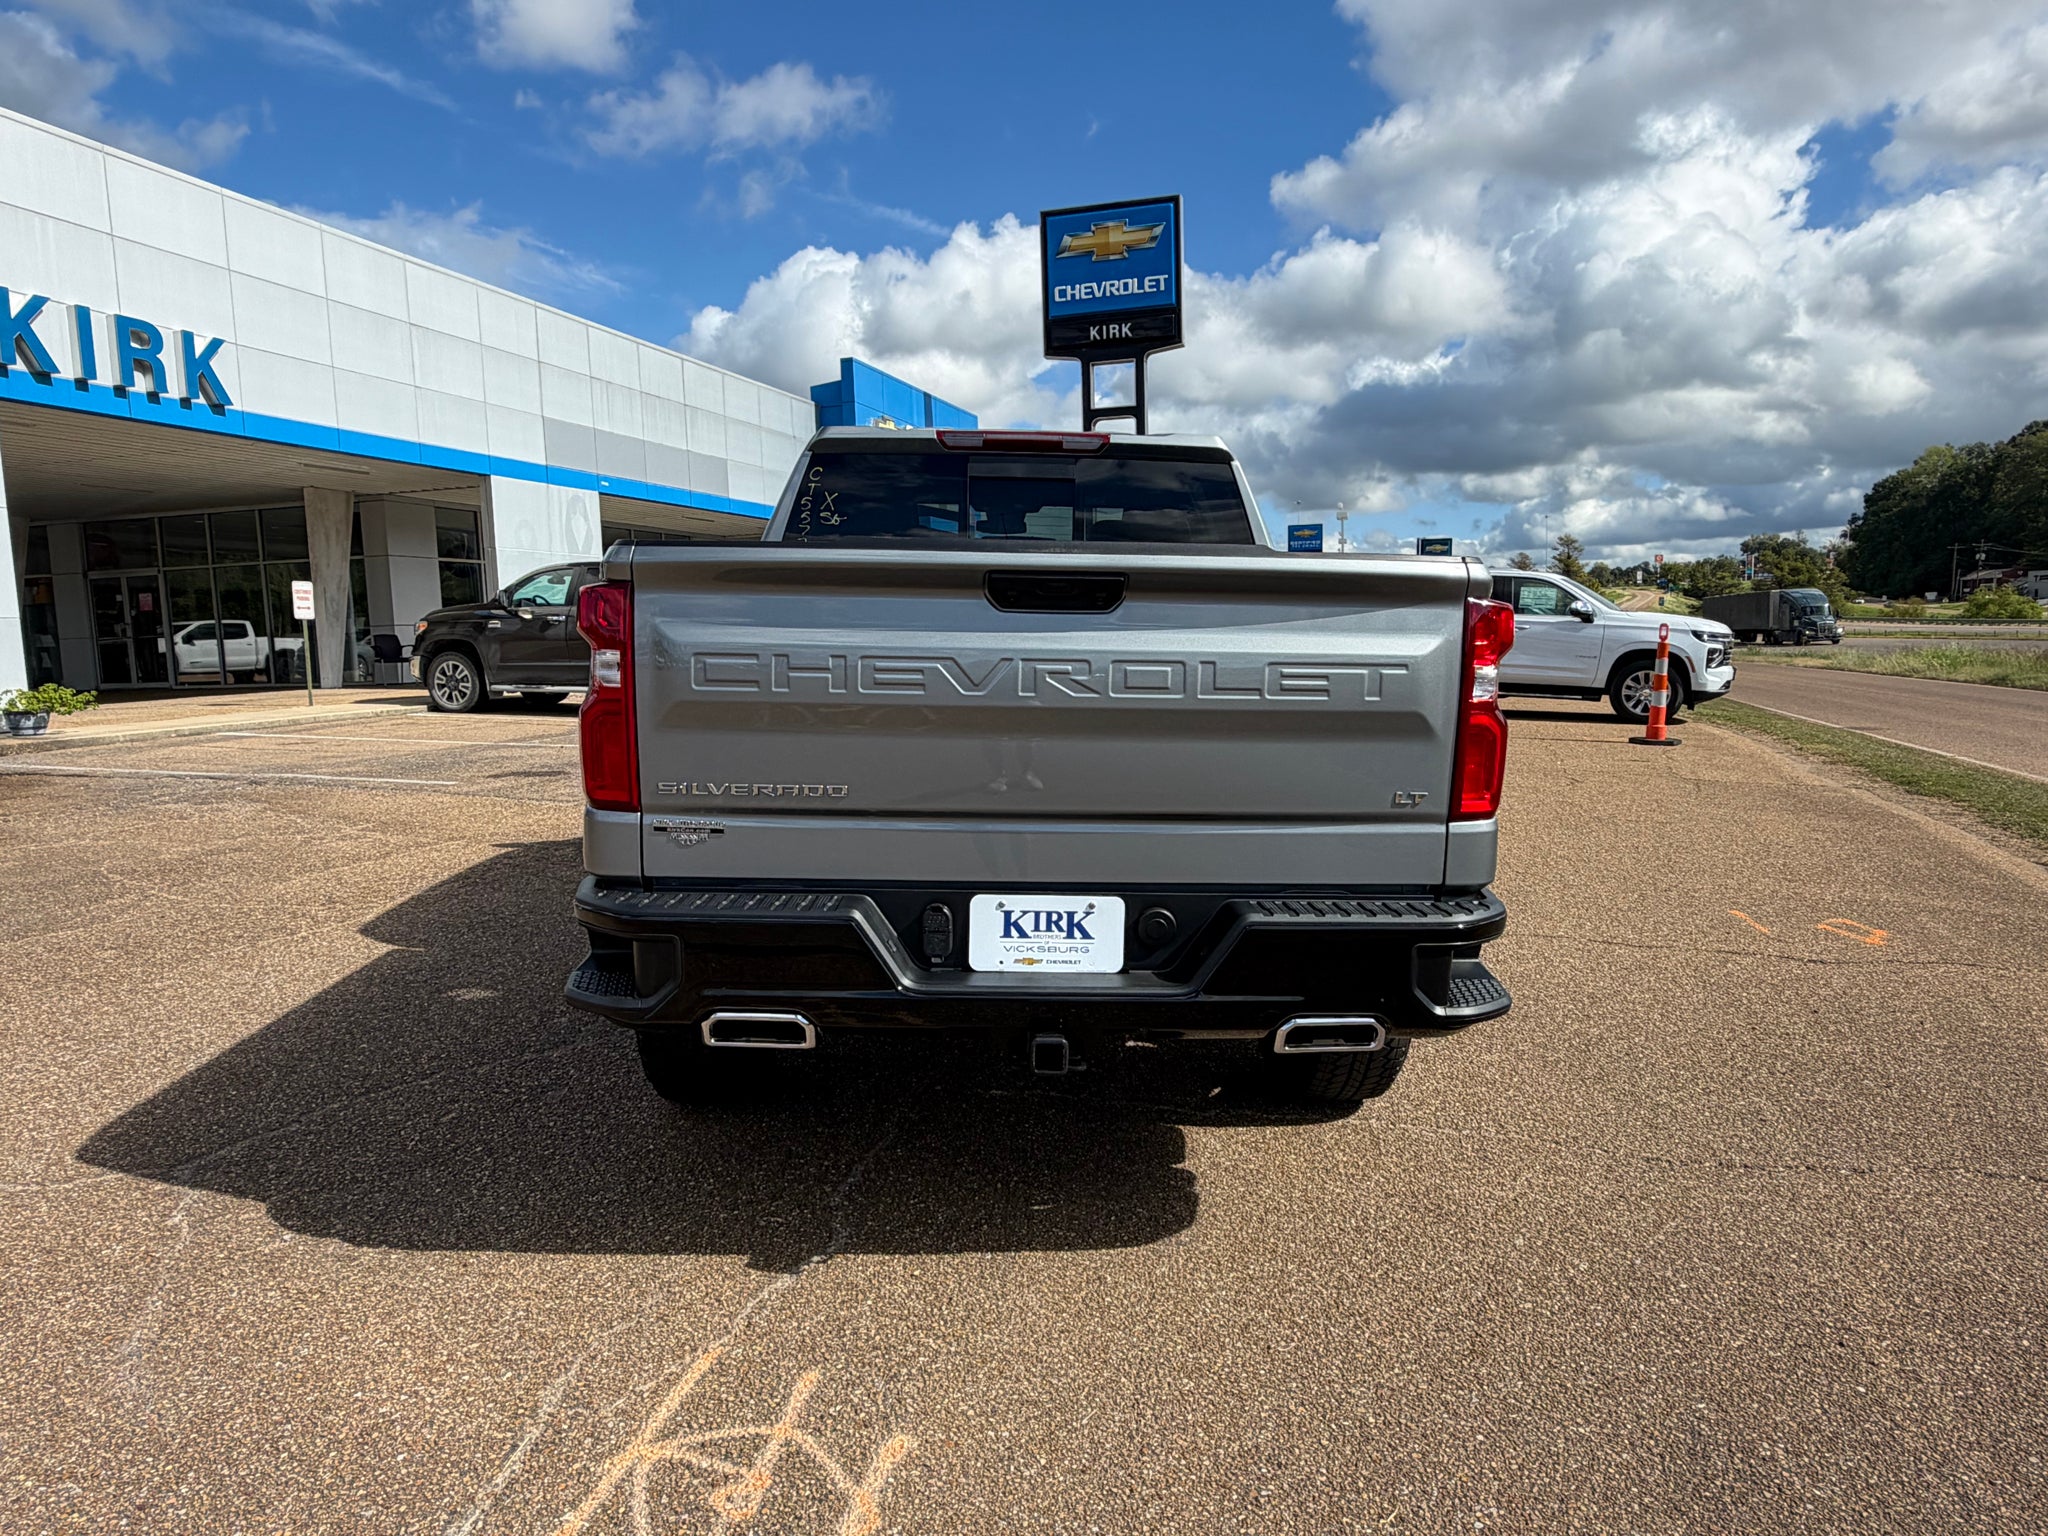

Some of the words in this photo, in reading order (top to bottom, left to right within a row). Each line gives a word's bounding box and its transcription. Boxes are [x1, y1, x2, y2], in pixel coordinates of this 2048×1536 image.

[1053, 274, 1169, 303] CHEVROLET
[1090, 322, 1133, 341] KIRK
[0, 285, 234, 406] KIRK
[691, 653, 1409, 701] CHEVROLET
[657, 781, 849, 797] SILVERADO
[1394, 791, 1429, 804] LT
[999, 910, 1095, 940] KIRK
[1003, 945, 1090, 954] VICKSBURG
